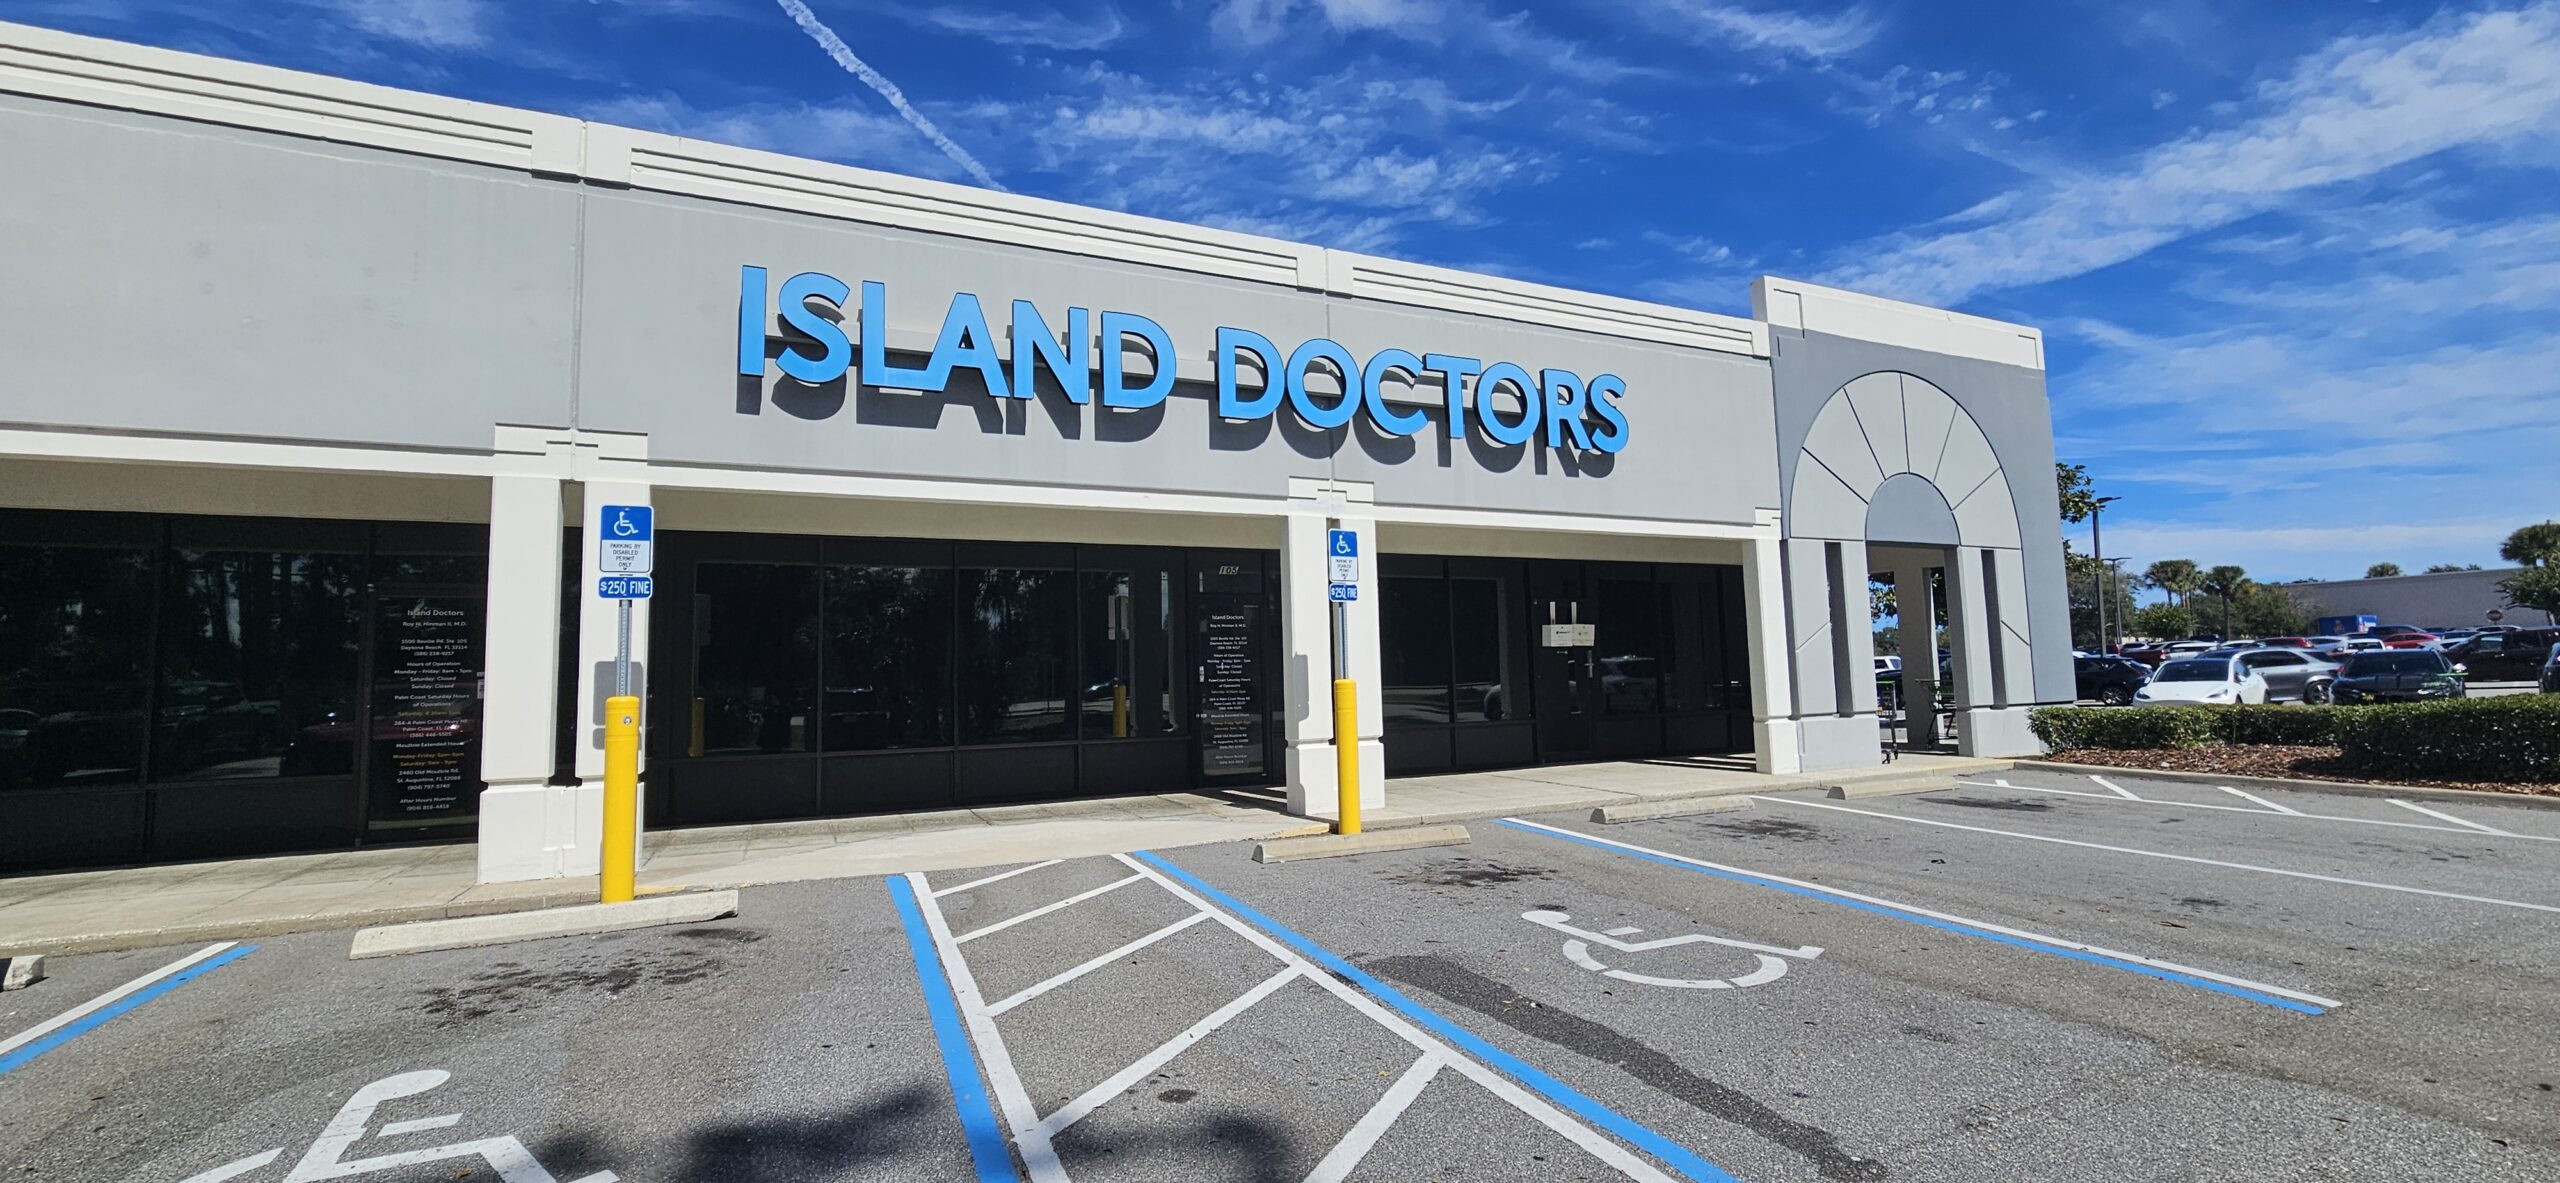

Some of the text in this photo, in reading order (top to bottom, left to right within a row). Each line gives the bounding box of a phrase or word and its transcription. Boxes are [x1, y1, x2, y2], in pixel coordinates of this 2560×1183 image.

[739, 265, 1629, 453] ISLAND DOCTORS
[600, 580, 650, 594] $250 FINE
